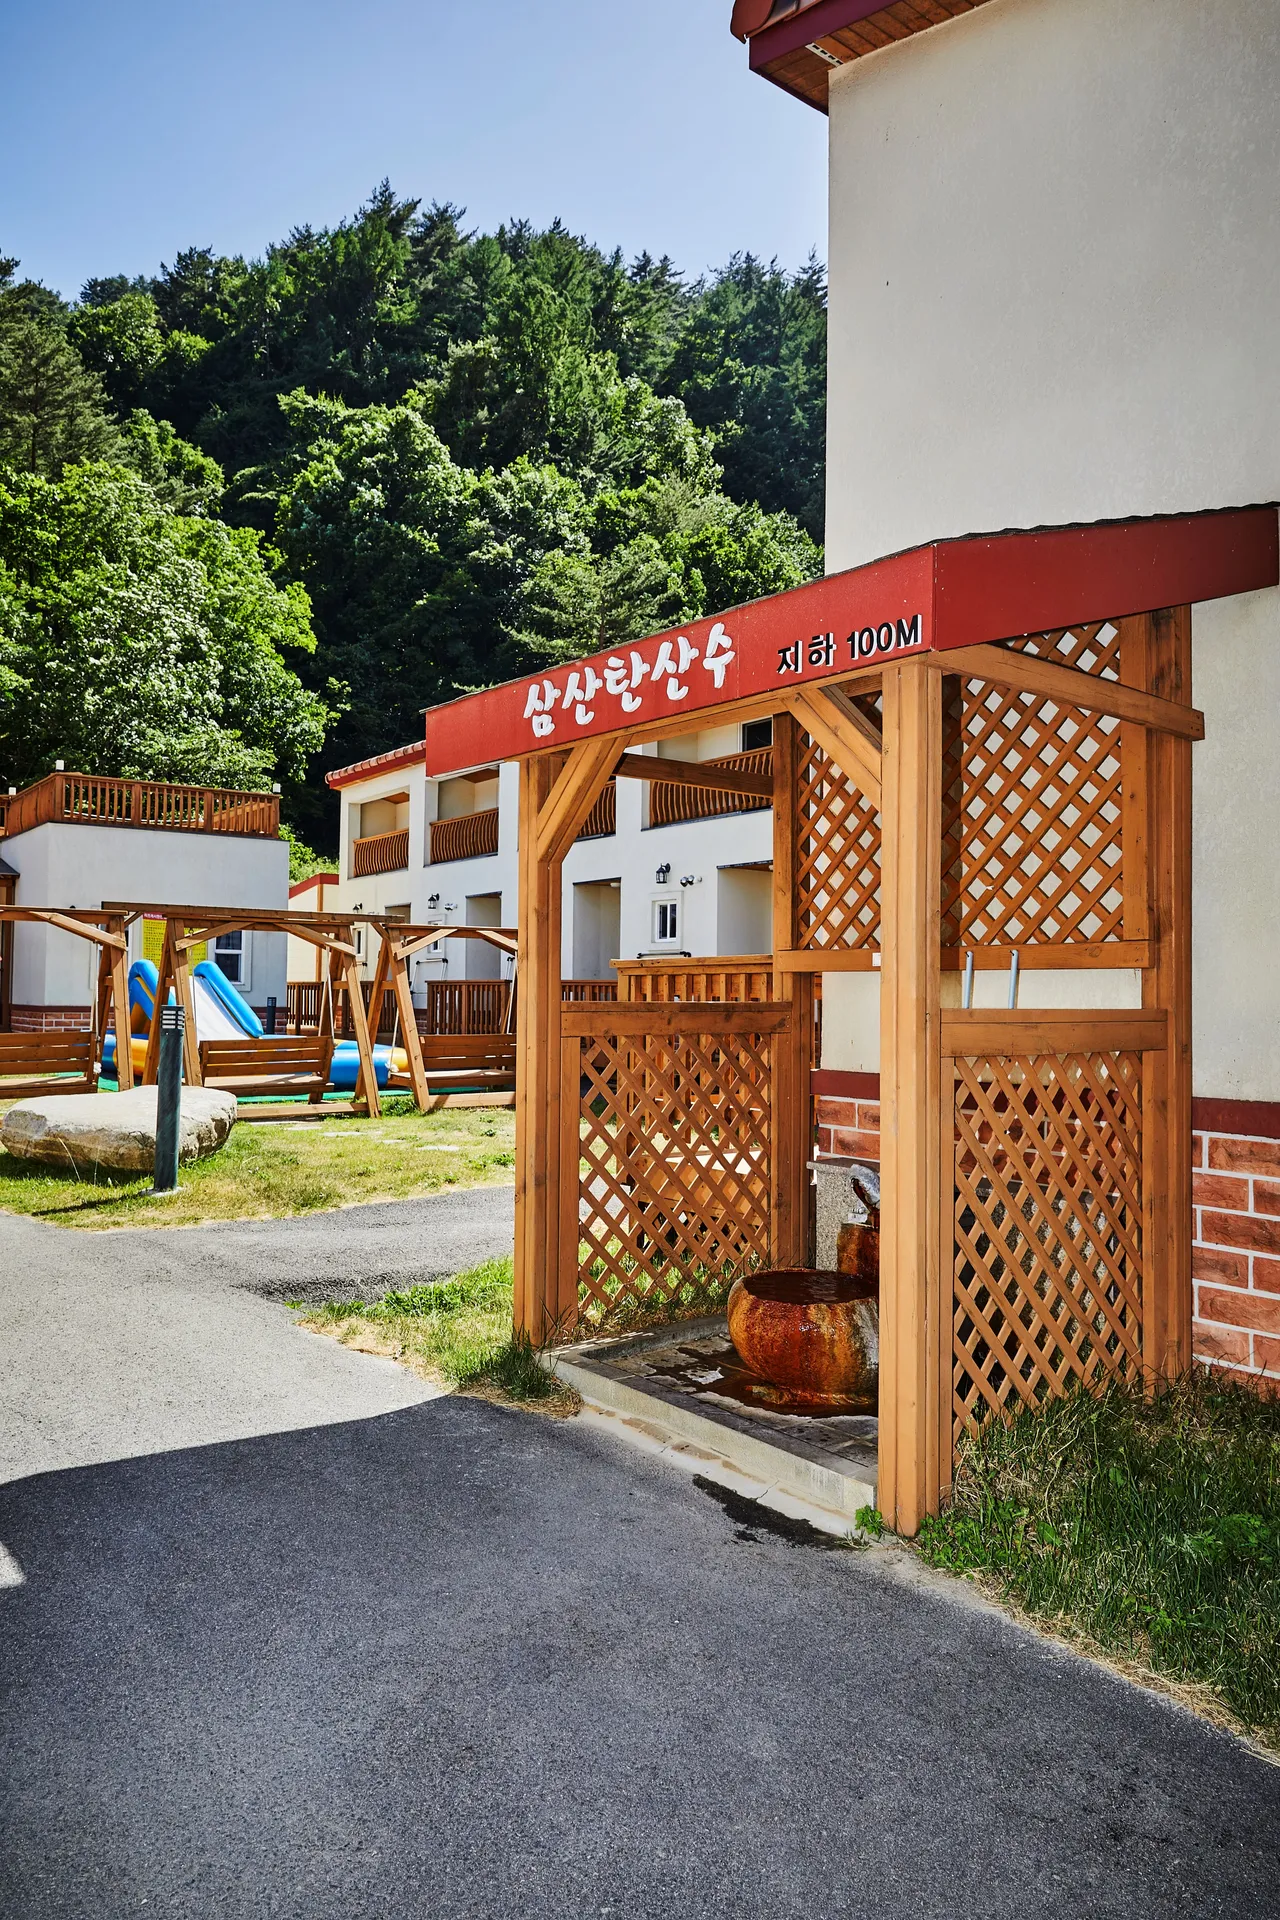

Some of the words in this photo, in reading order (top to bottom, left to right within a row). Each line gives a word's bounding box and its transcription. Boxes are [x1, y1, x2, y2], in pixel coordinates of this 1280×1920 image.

[523, 622, 736, 738] 삼산탄산수
[776, 632, 837, 675] 지하
[846, 613, 922, 660] 100M
